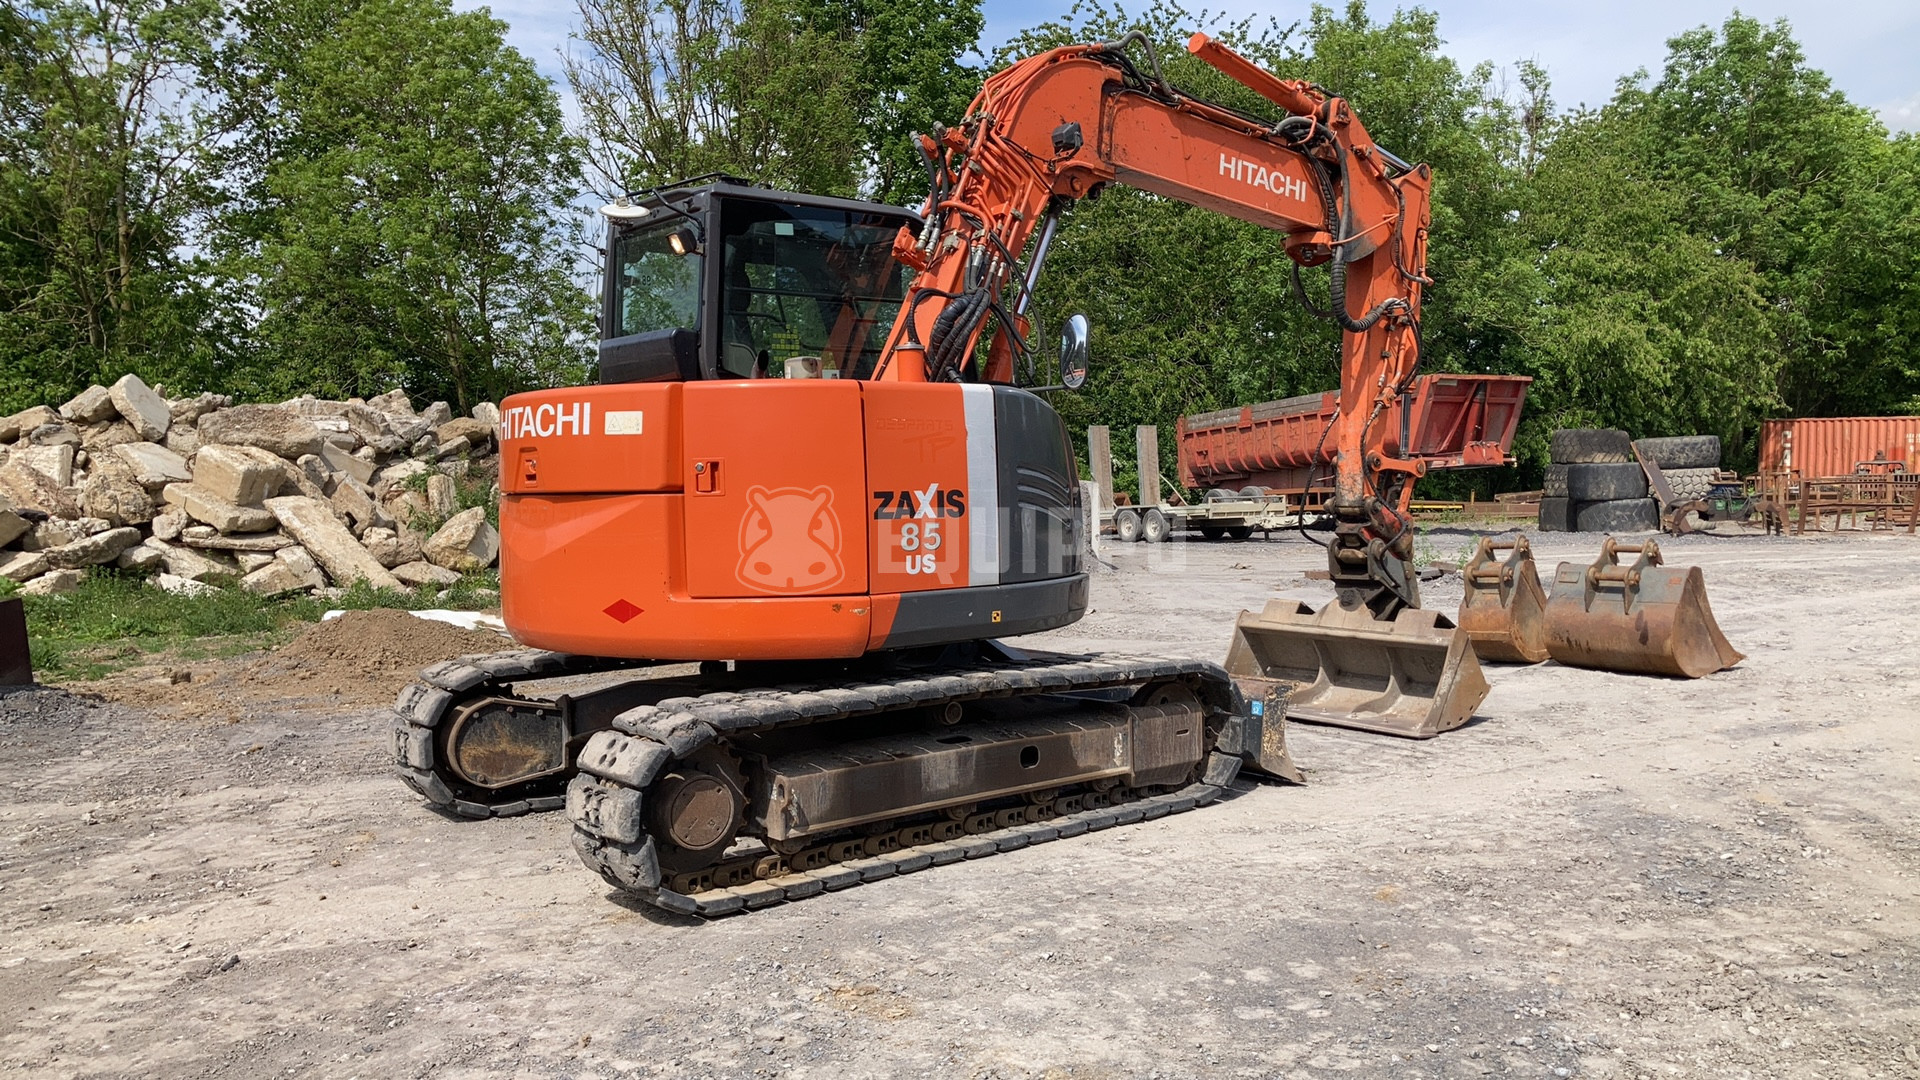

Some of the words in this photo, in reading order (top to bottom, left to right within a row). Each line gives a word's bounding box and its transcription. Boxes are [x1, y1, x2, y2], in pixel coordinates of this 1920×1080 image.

[1219, 153, 1307, 202] HITACHI
[501, 402, 591, 441] HITACHI
[873, 483, 965, 520] ZAXIS
[901, 523, 941, 551] 85
[905, 553, 937, 575] US
